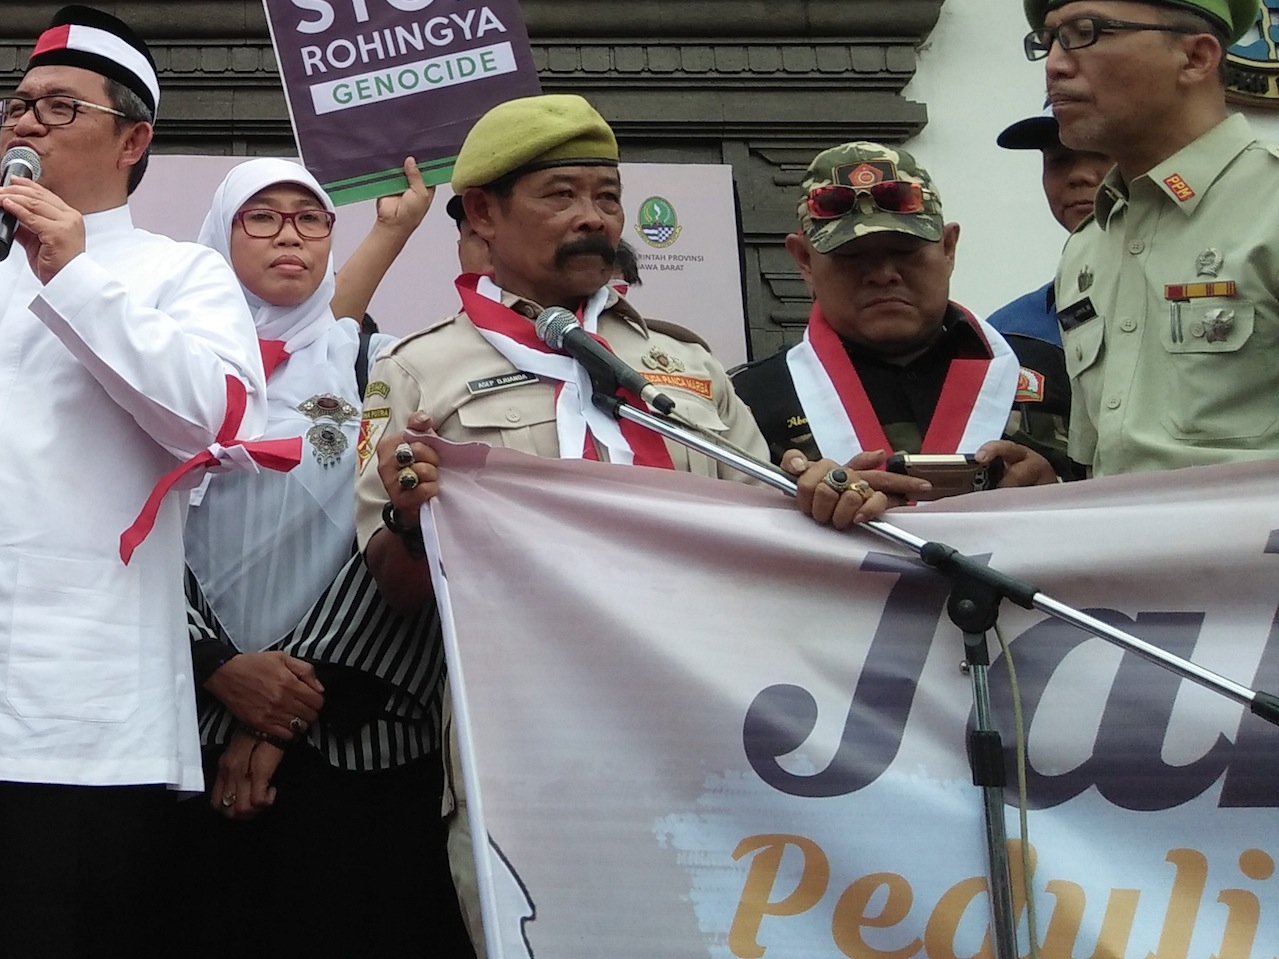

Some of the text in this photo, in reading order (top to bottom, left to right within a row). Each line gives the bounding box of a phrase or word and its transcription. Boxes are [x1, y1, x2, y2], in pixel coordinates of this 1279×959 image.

[300, 6, 508, 77] ROHINGYA
[331, 51, 498, 106] GENOCIDE
[1166, 176, 1193, 199] PPM
[636, 253, 704, 262] RINTAH PROVINSI
[477, 380, 495, 389] ASEP
[726, 833, 1277, 959] Peduli
